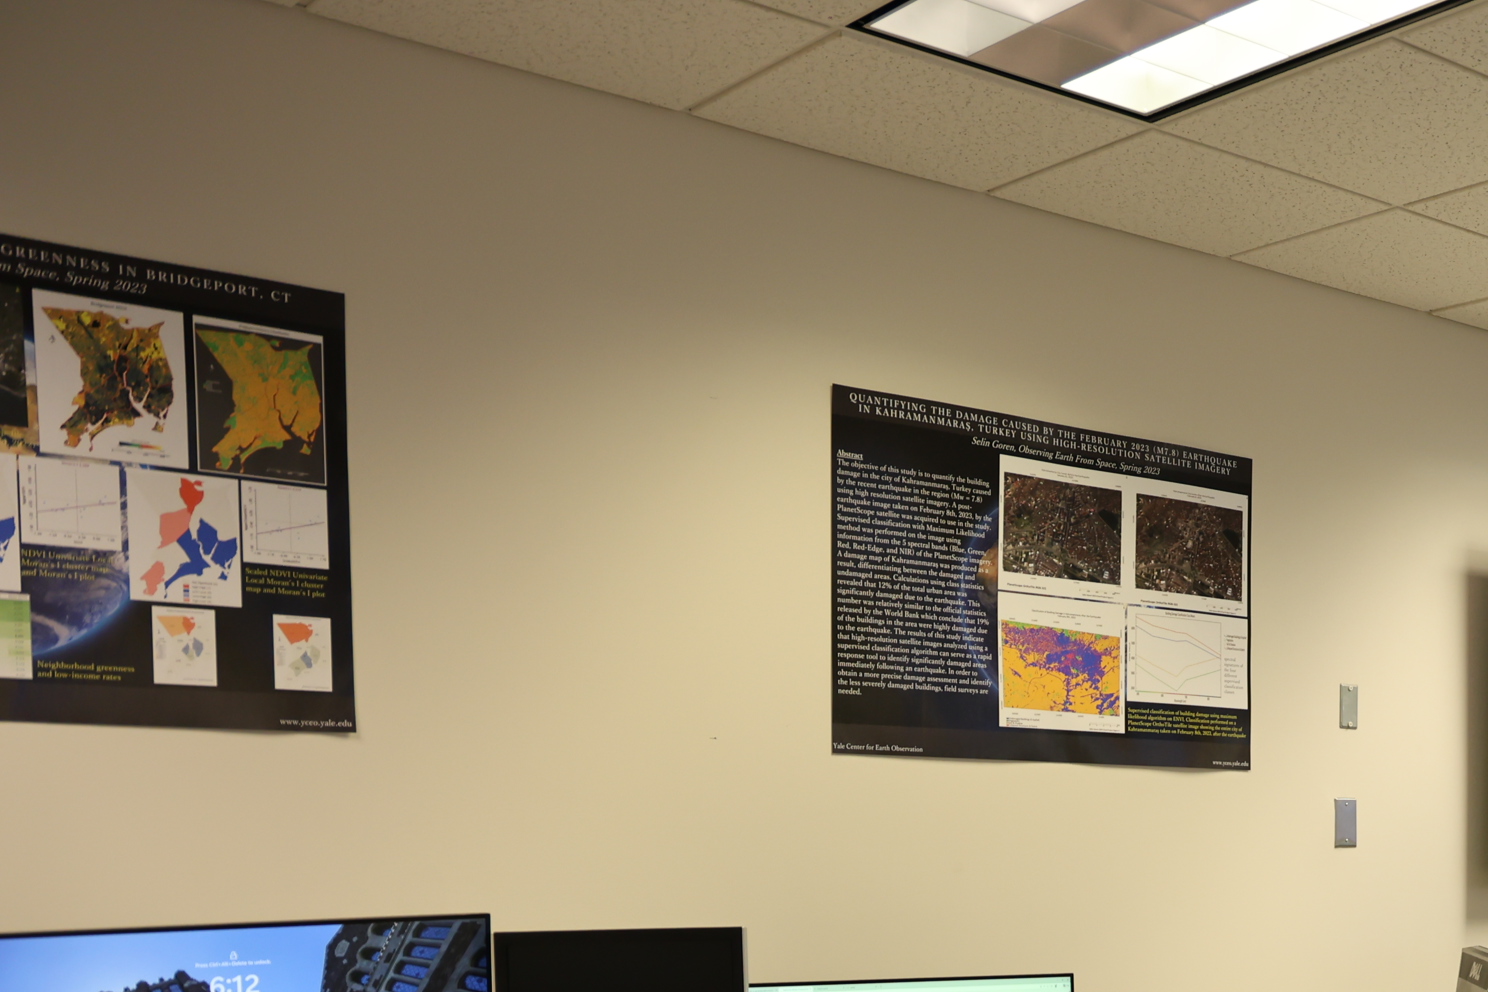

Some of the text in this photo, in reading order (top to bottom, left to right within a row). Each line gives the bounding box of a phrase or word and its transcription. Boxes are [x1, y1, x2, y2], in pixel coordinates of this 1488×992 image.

[1, 243, 110, 273] GREENNESS
[119, 264, 137, 277] IN
[146, 269, 262, 299] BRIDGEPORT,
[270, 290, 291, 304] CT
[16, 264, 60, 282] Space,
[65, 271, 110, 291] Spring
[113, 279, 148, 295] 2023
[849, 392, 1237, 468] QUANTIFYING THE DAMAGE CAUSED BY THE FEBRUARY 2023 (M7.8) EARTHQUAKE
[858, 404, 870, 413] IN
[978, 424, 1016, 438] TURKEY
[1020, 432, 1049, 444] USING
[1053, 438, 1140, 459] HIGH-RESOLUTION
[1145, 454, 1192, 468] SATELLITE
[1195, 462, 1231, 475] IMAGERY
[836, 449, 863, 460] Abstract
[971, 436, 1161, 475] Selin Goren, Observing Earth From Space, Spring 2023
[836, 458, 850, 467] The
[850, 461, 879, 470] objective
[879, 464, 887, 472] of
[887, 465, 899, 473] this
[900, 468, 917, 477] study
[917, 469, 923, 477] is
[931, 473, 955, 482] quantify
[956, 475, 966, 483] the
[966, 476, 990, 487] building
[836, 469, 861, 478] damage
[880, 474, 893, 483] city
[972, 488, 992, 496] caused
[836, 477, 845, 486] by
[845, 478, 856, 486] the
[877, 483, 912, 493] earthquake
[912, 486, 919, 494] in
[920, 487, 930, 496] the
[931, 490, 950, 498] region
[22, 549, 46, 557] NDVI
[19, 567, 37, 578] and
[79, 572, 98, 583] plot
[245, 567, 327, 580] Scaled NDVI Univariate
[245, 576, 265, 584] Local
[300, 580, 323, 589] cluster
[245, 586, 261, 594] map
[311, 590, 325, 598] plot
[37, 660, 94, 673] Neighborhood
[37, 670, 52, 678] and
[845, 742, 865, 750] Center
[890, 744, 923, 752] Observation
